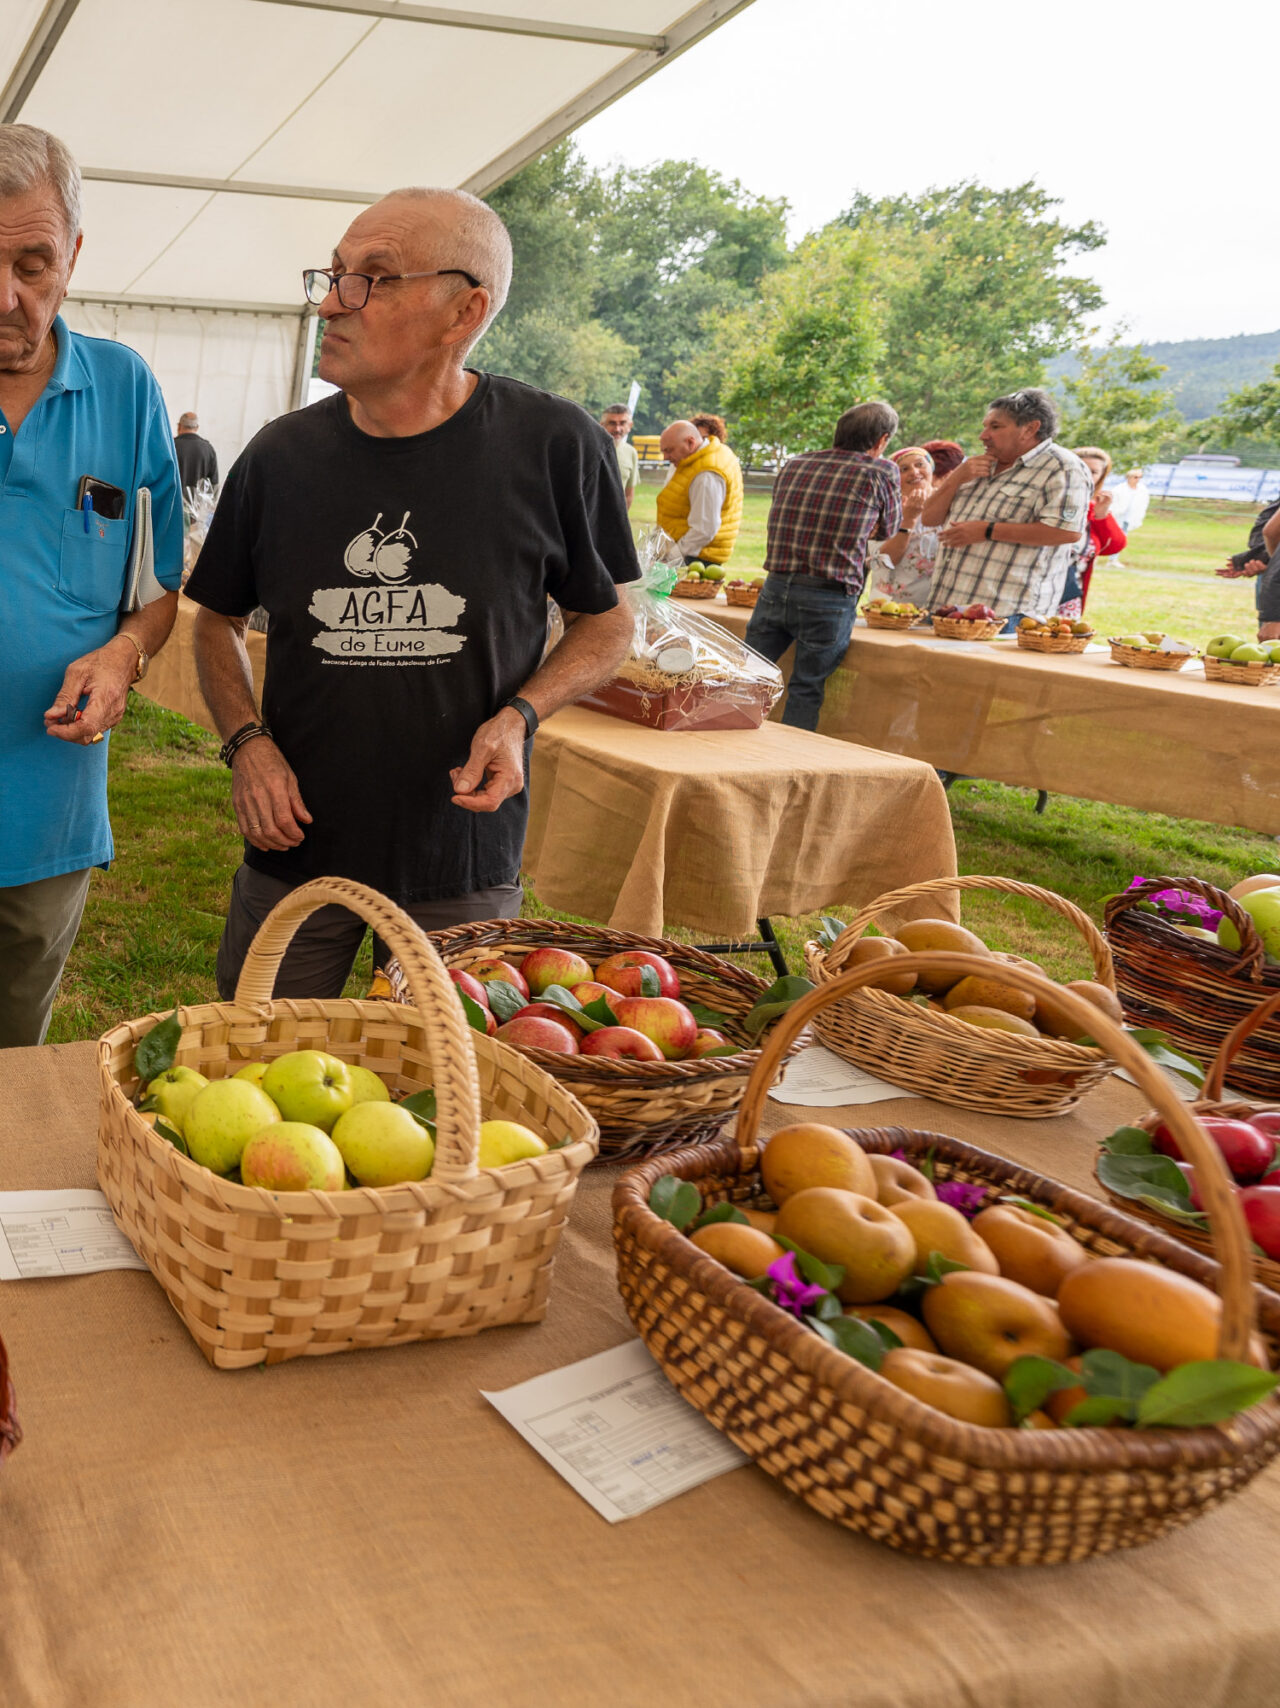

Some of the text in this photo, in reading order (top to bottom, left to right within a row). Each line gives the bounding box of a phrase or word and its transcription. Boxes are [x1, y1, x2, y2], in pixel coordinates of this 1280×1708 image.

[339, 589, 428, 627] AGFA
[340, 633, 426, 652] do Eume
